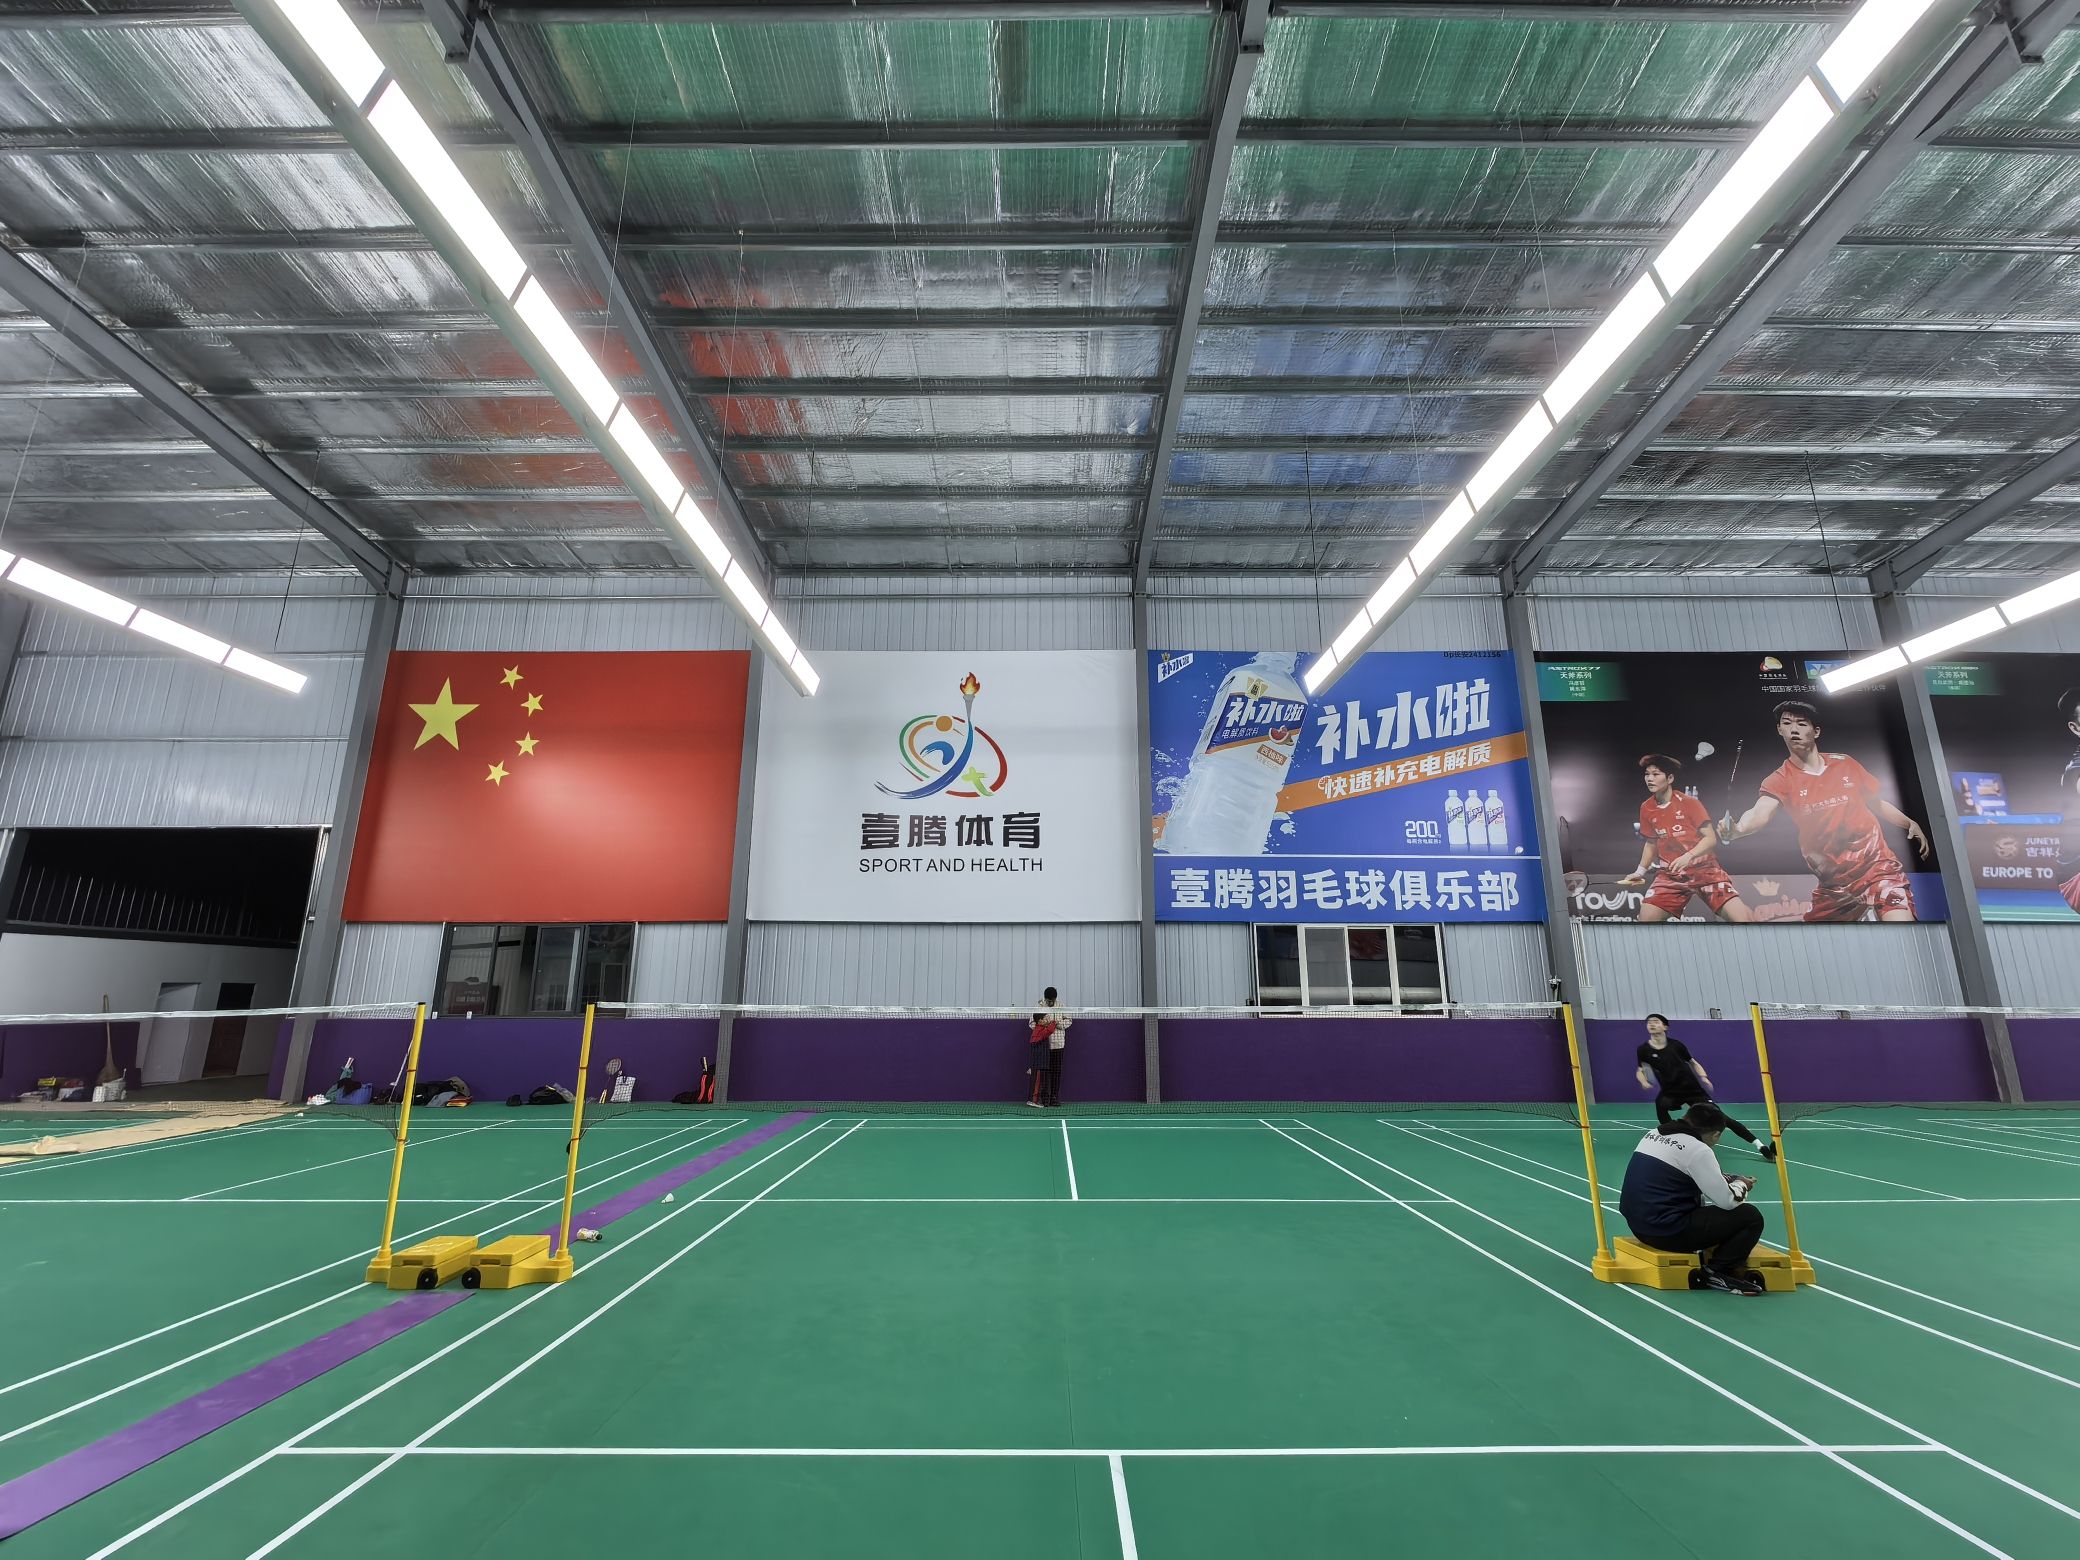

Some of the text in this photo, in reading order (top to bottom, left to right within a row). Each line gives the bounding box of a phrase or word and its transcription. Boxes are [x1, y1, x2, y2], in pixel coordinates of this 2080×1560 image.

[1225, 696, 1305, 728] 补水啦
[1315, 677, 1491, 766] 补水啦
[1221, 727, 1260, 739] 电解质饮料
[1323, 742, 1492, 799] 快速补充电解质
[860, 812, 1041, 850] 壹腾体育
[859, 857, 1043, 873] SPORT AND HEALTH
[2025, 846, 2060, 857] 吉祥
[1982, 866, 2054, 878] EUROPE TO
[1170, 868, 1520, 911] 壹腾羽毛球俱乐部
